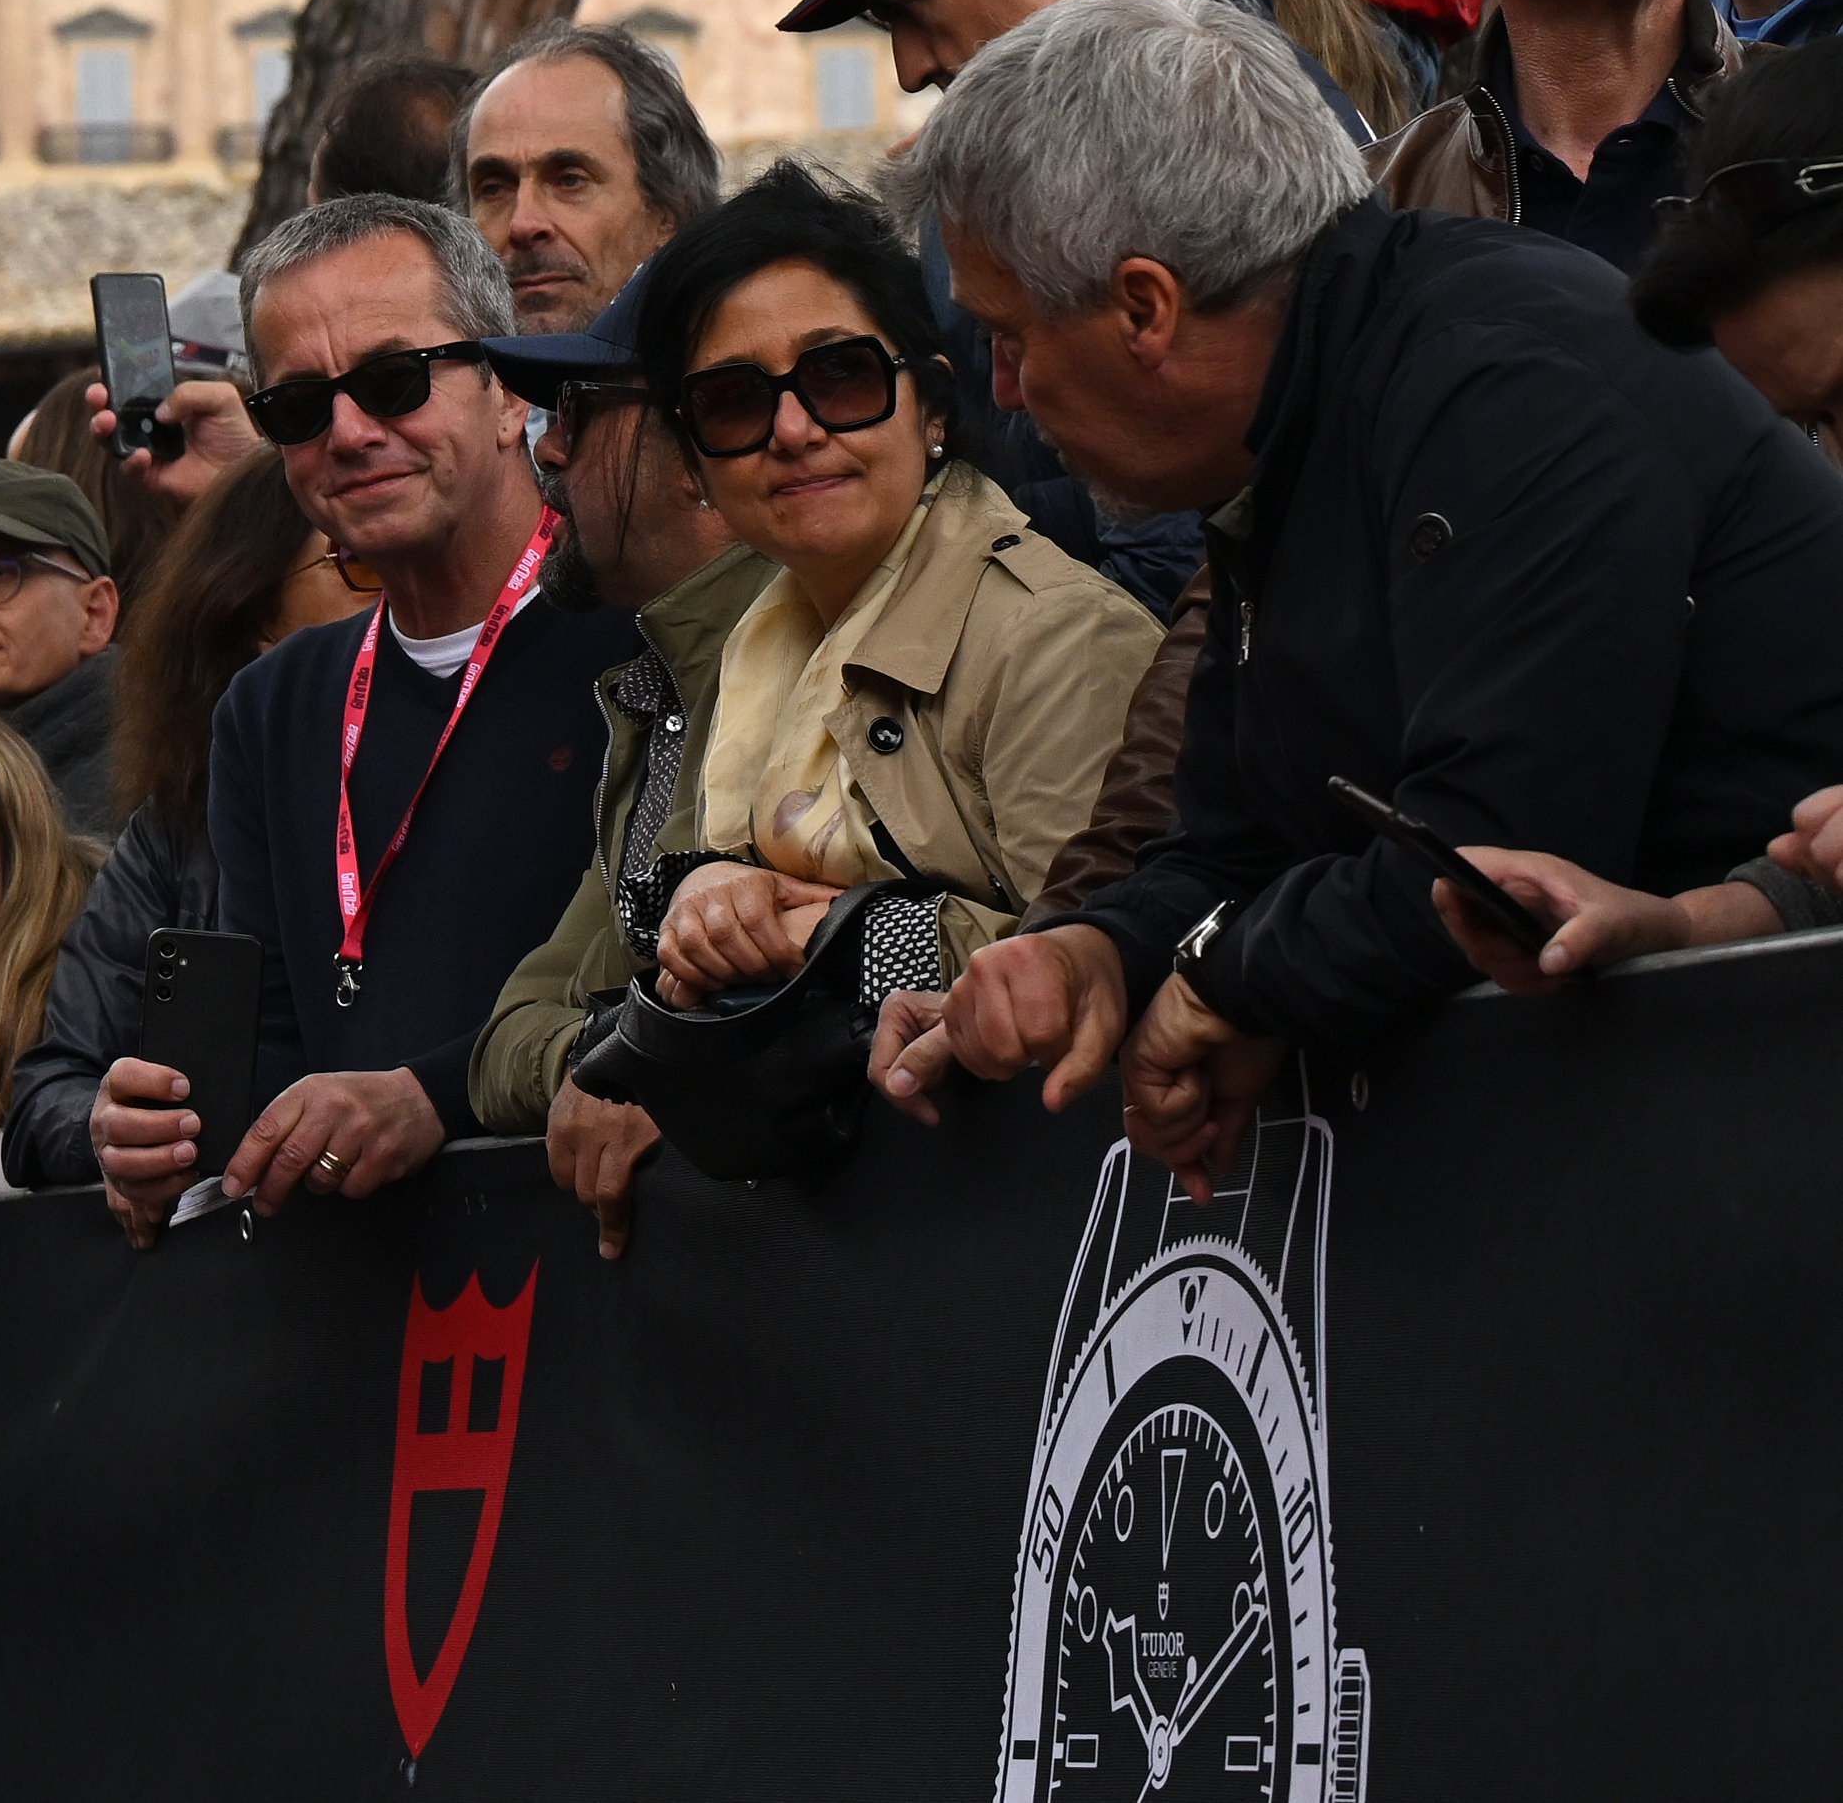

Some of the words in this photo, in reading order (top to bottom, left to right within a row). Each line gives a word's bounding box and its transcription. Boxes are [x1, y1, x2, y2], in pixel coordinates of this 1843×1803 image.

[1032, 1484, 1065, 1585] 50
[1282, 1477, 1314, 1565] 10
[1141, 1632, 1184, 1657] TUDOR
[1147, 1661, 1178, 1679] GENEVE
